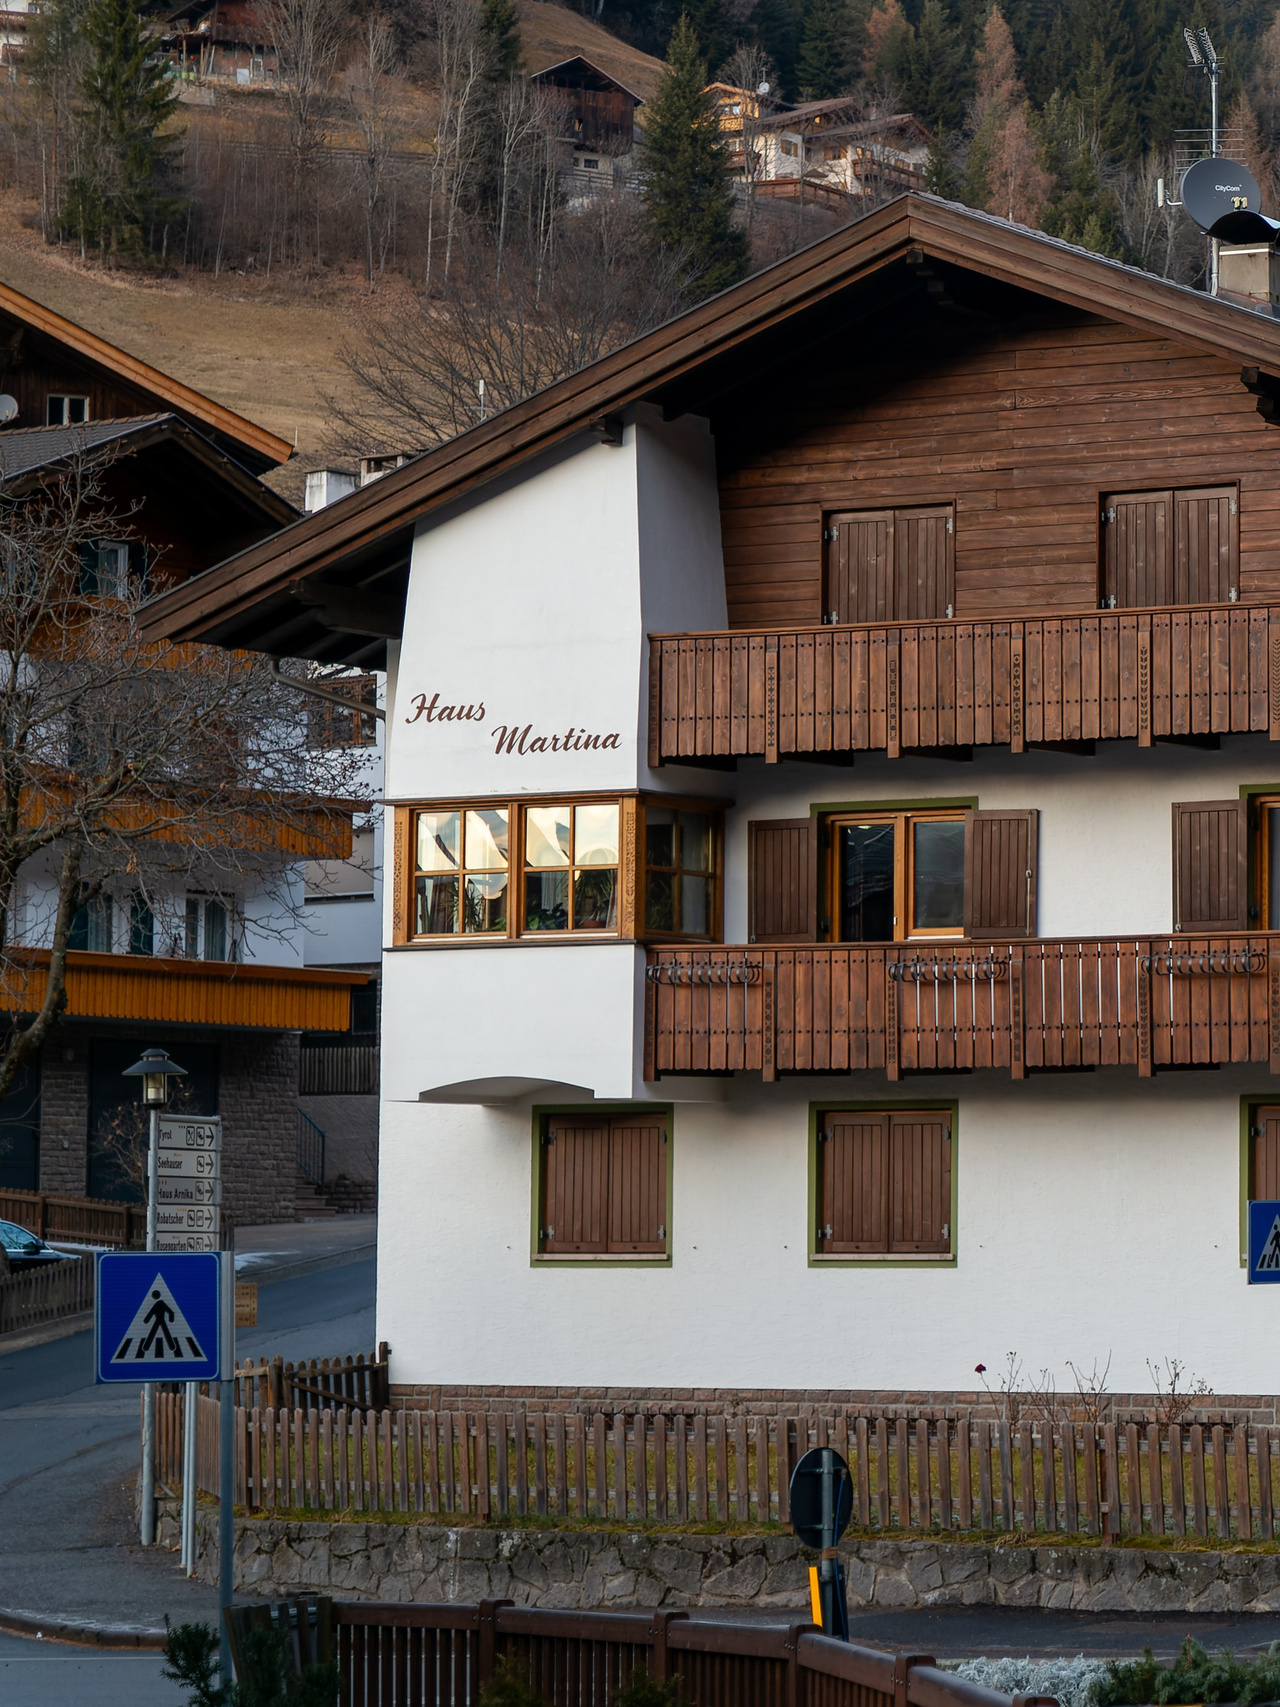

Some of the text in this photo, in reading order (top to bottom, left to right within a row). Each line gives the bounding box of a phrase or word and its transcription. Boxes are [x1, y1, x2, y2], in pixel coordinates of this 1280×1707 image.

[1215, 184, 1240, 192] CityCom
[405, 693, 486, 724] Haus
[491, 724, 622, 756] Martina
[158, 1156, 183, 1169] Seehauser
[173, 1188, 194, 1199] Arnika
